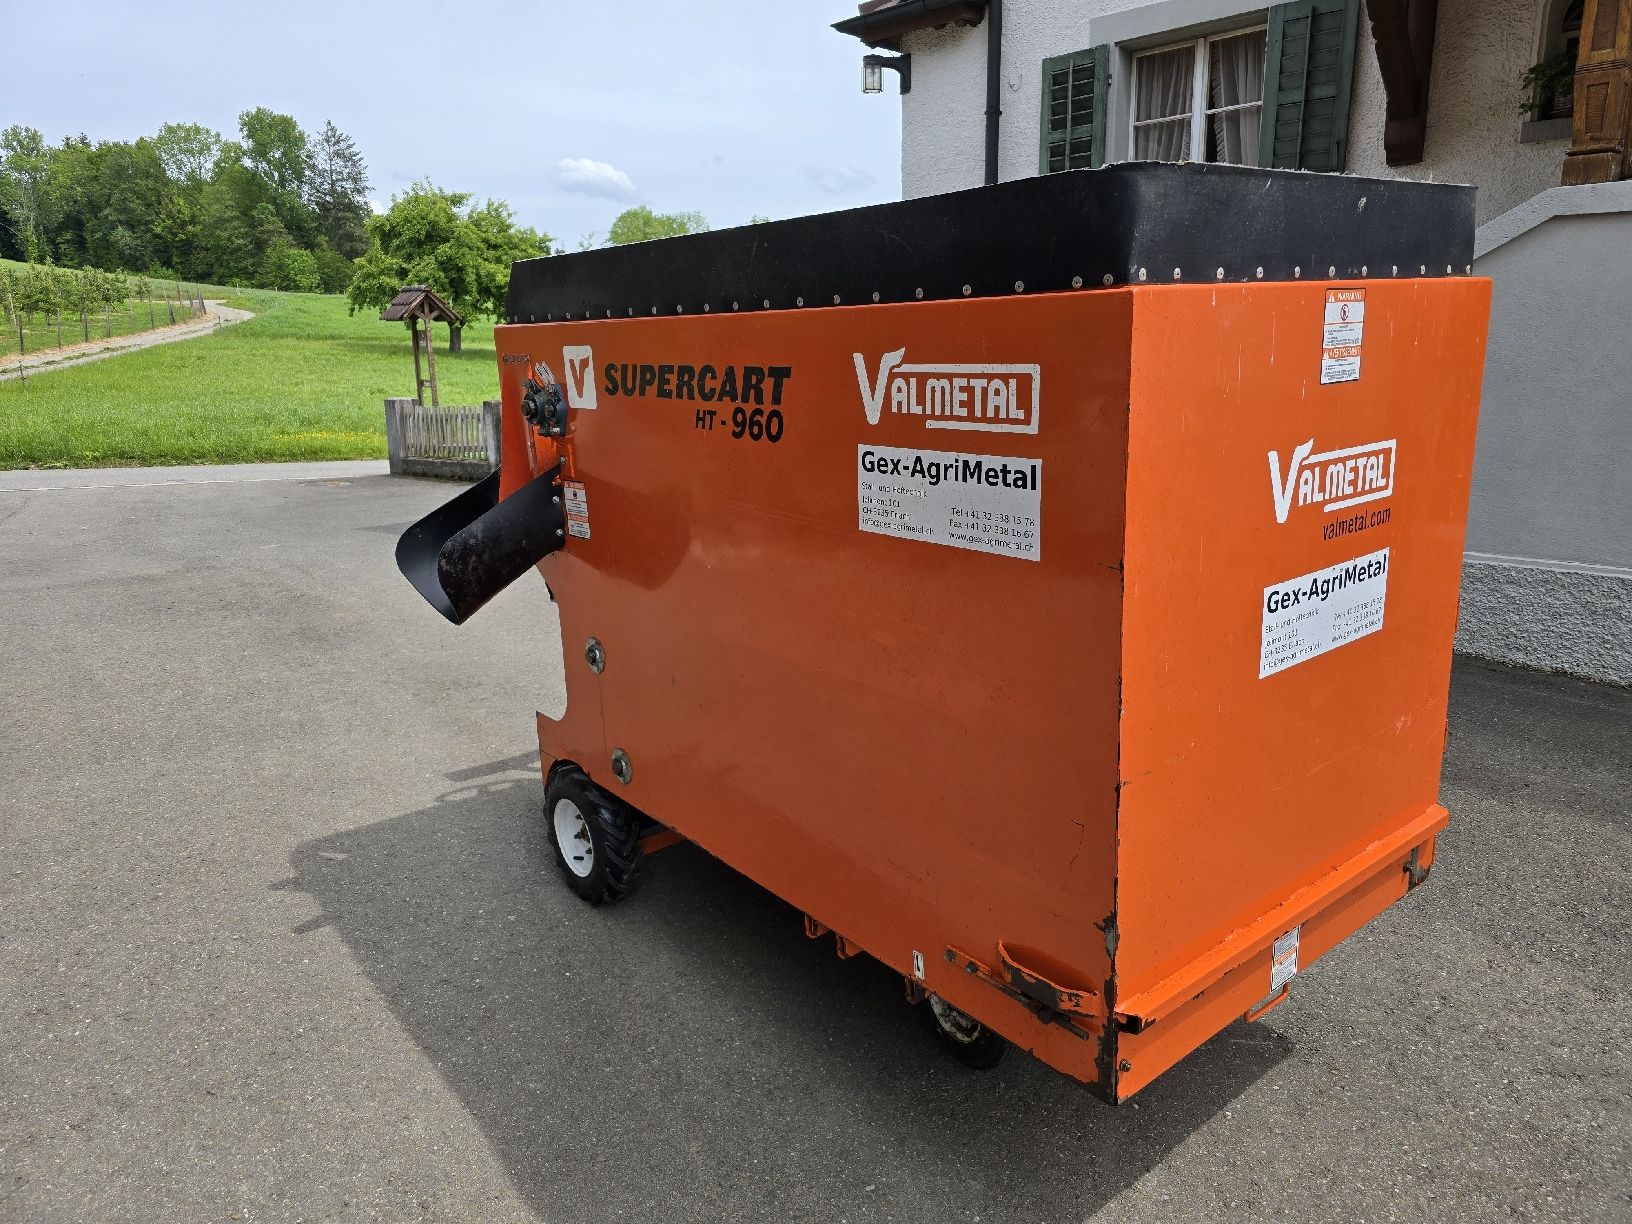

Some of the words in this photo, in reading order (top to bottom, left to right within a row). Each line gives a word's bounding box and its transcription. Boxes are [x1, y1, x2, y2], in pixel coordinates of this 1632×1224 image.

[604, 363, 792, 406] SUPERCART
[852, 346, 1025, 426] VALMETAL
[861, 450, 1038, 490] Gex-AgriMetal
[1268, 437, 1387, 524] VALMETAL
[949, 518, 963, 528] Fax
[982, 523, 992, 533] 32
[994, 525, 1009, 536] 338
[1011, 528, 1022, 538] 16
[1024, 530, 1034, 539] 67
[951, 507, 963, 517] Tel
[982, 511, 992, 521] 32
[1323, 507, 1391, 541] valmetal.com
[1267, 553, 1387, 614] Gex-AgriMetal
